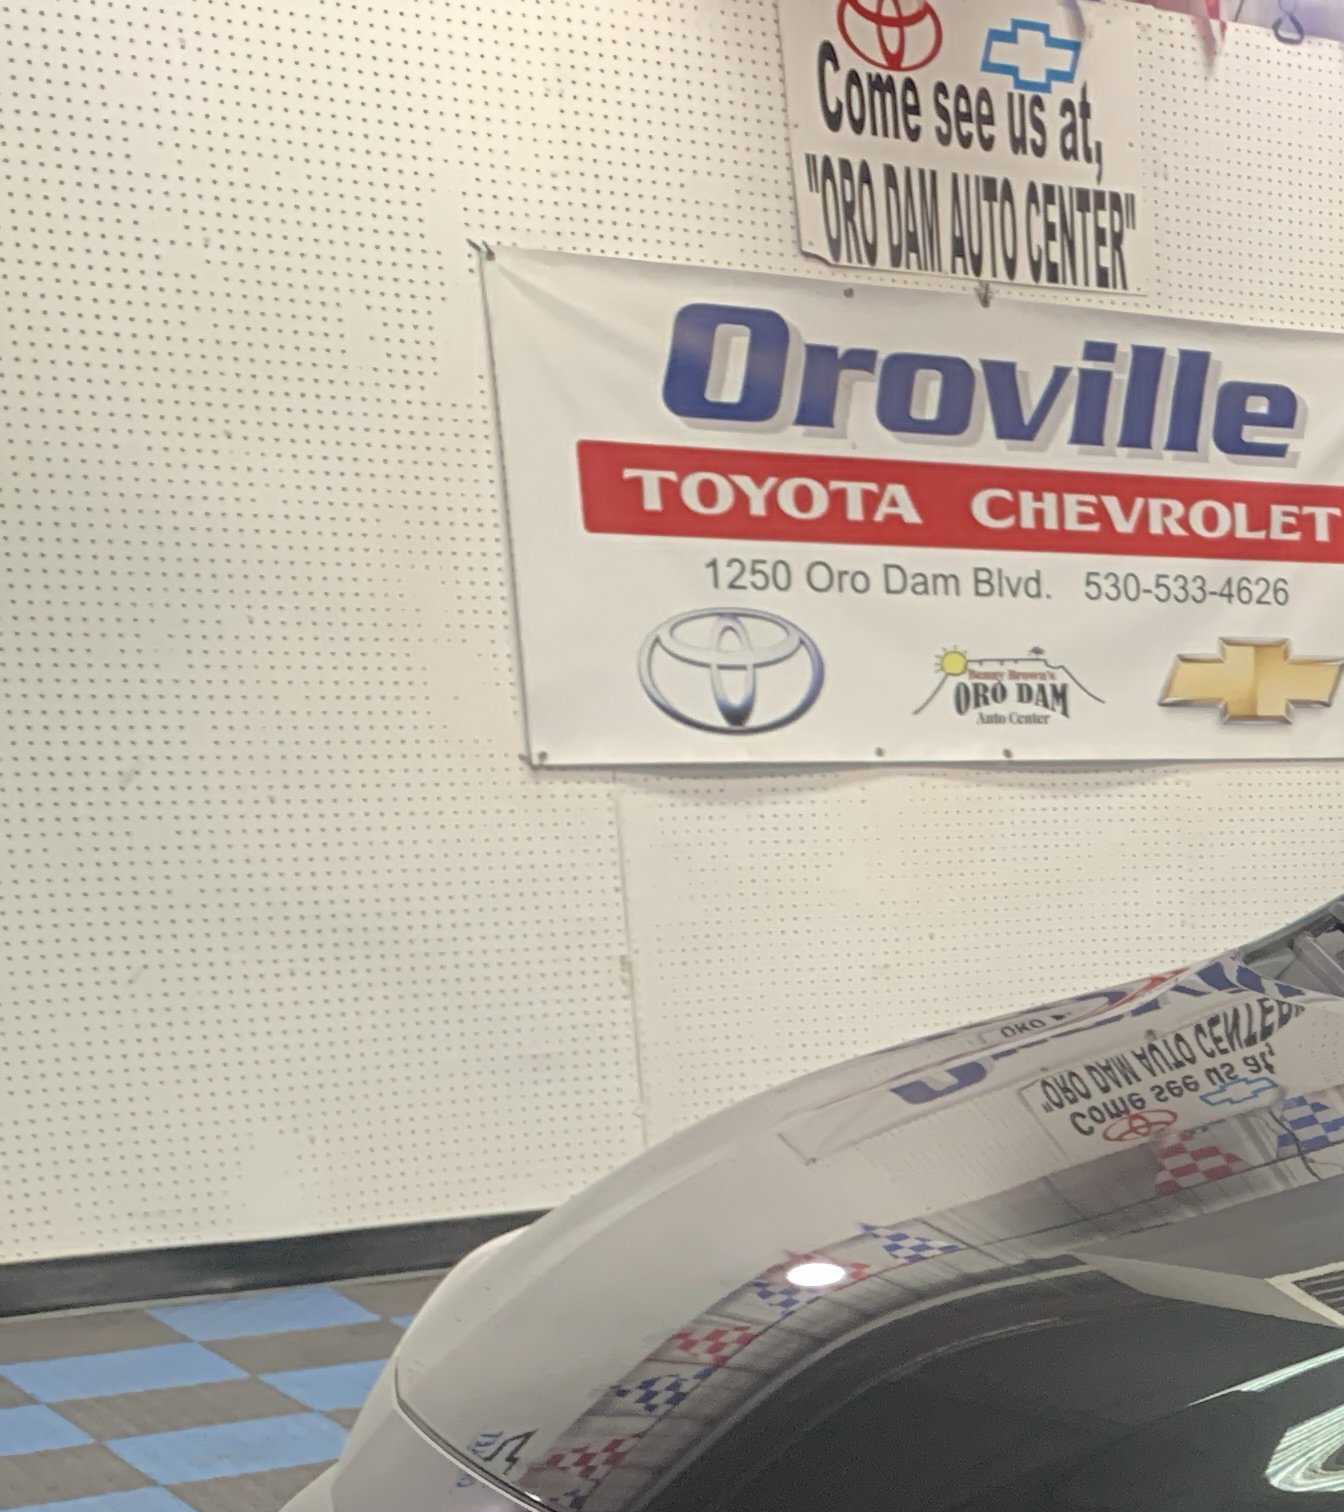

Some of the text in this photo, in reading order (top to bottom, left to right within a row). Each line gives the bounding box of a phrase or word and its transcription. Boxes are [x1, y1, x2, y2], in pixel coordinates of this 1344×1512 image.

[817, 40, 1102, 185] Come see us at,
[804, 153, 1137, 290] "ORO DAM AUTO CENTER"
[663, 302, 1300, 458] Oroville
[622, 468, 1341, 543] TOYOTA CHEVROLET
[704, 557, 1290, 606] 1250 Oro Dam Blvd. 530-533-4626
[954, 681, 1070, 719] ORO DAM
[976, 712, 1051, 725] Auto Center
